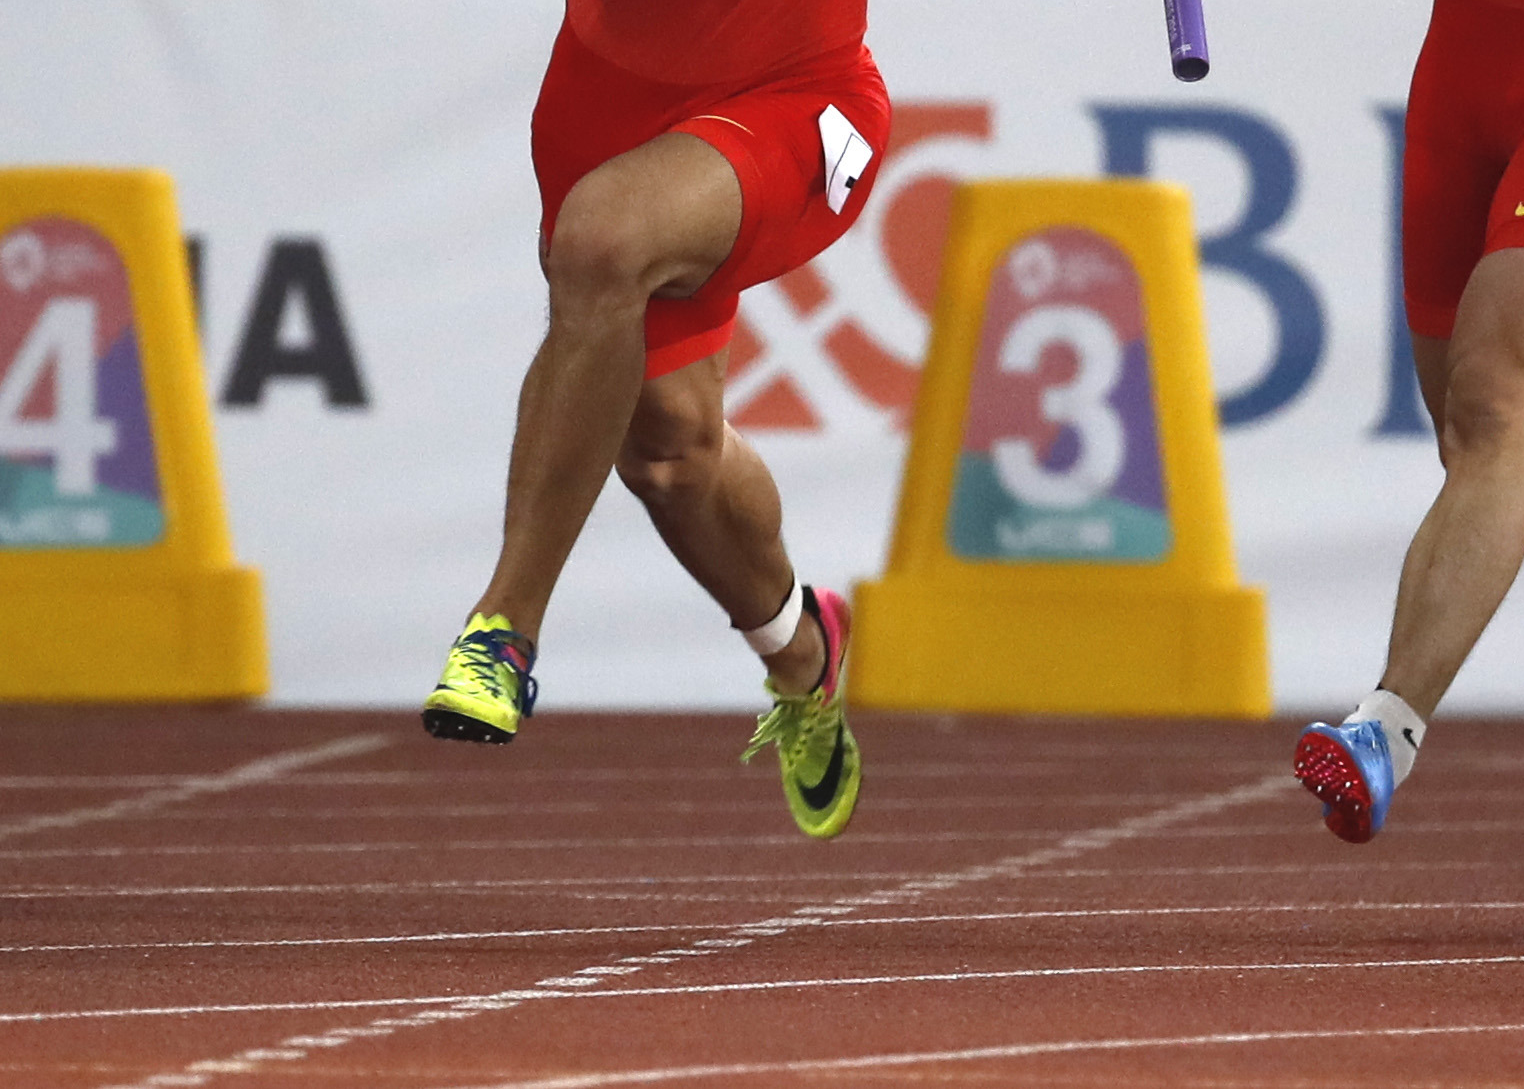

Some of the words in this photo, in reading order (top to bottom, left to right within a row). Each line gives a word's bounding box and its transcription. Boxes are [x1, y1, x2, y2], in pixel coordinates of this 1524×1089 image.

[0, 296, 118, 496] 4
[186, 233, 372, 411] A
[992, 303, 1127, 509] 3
